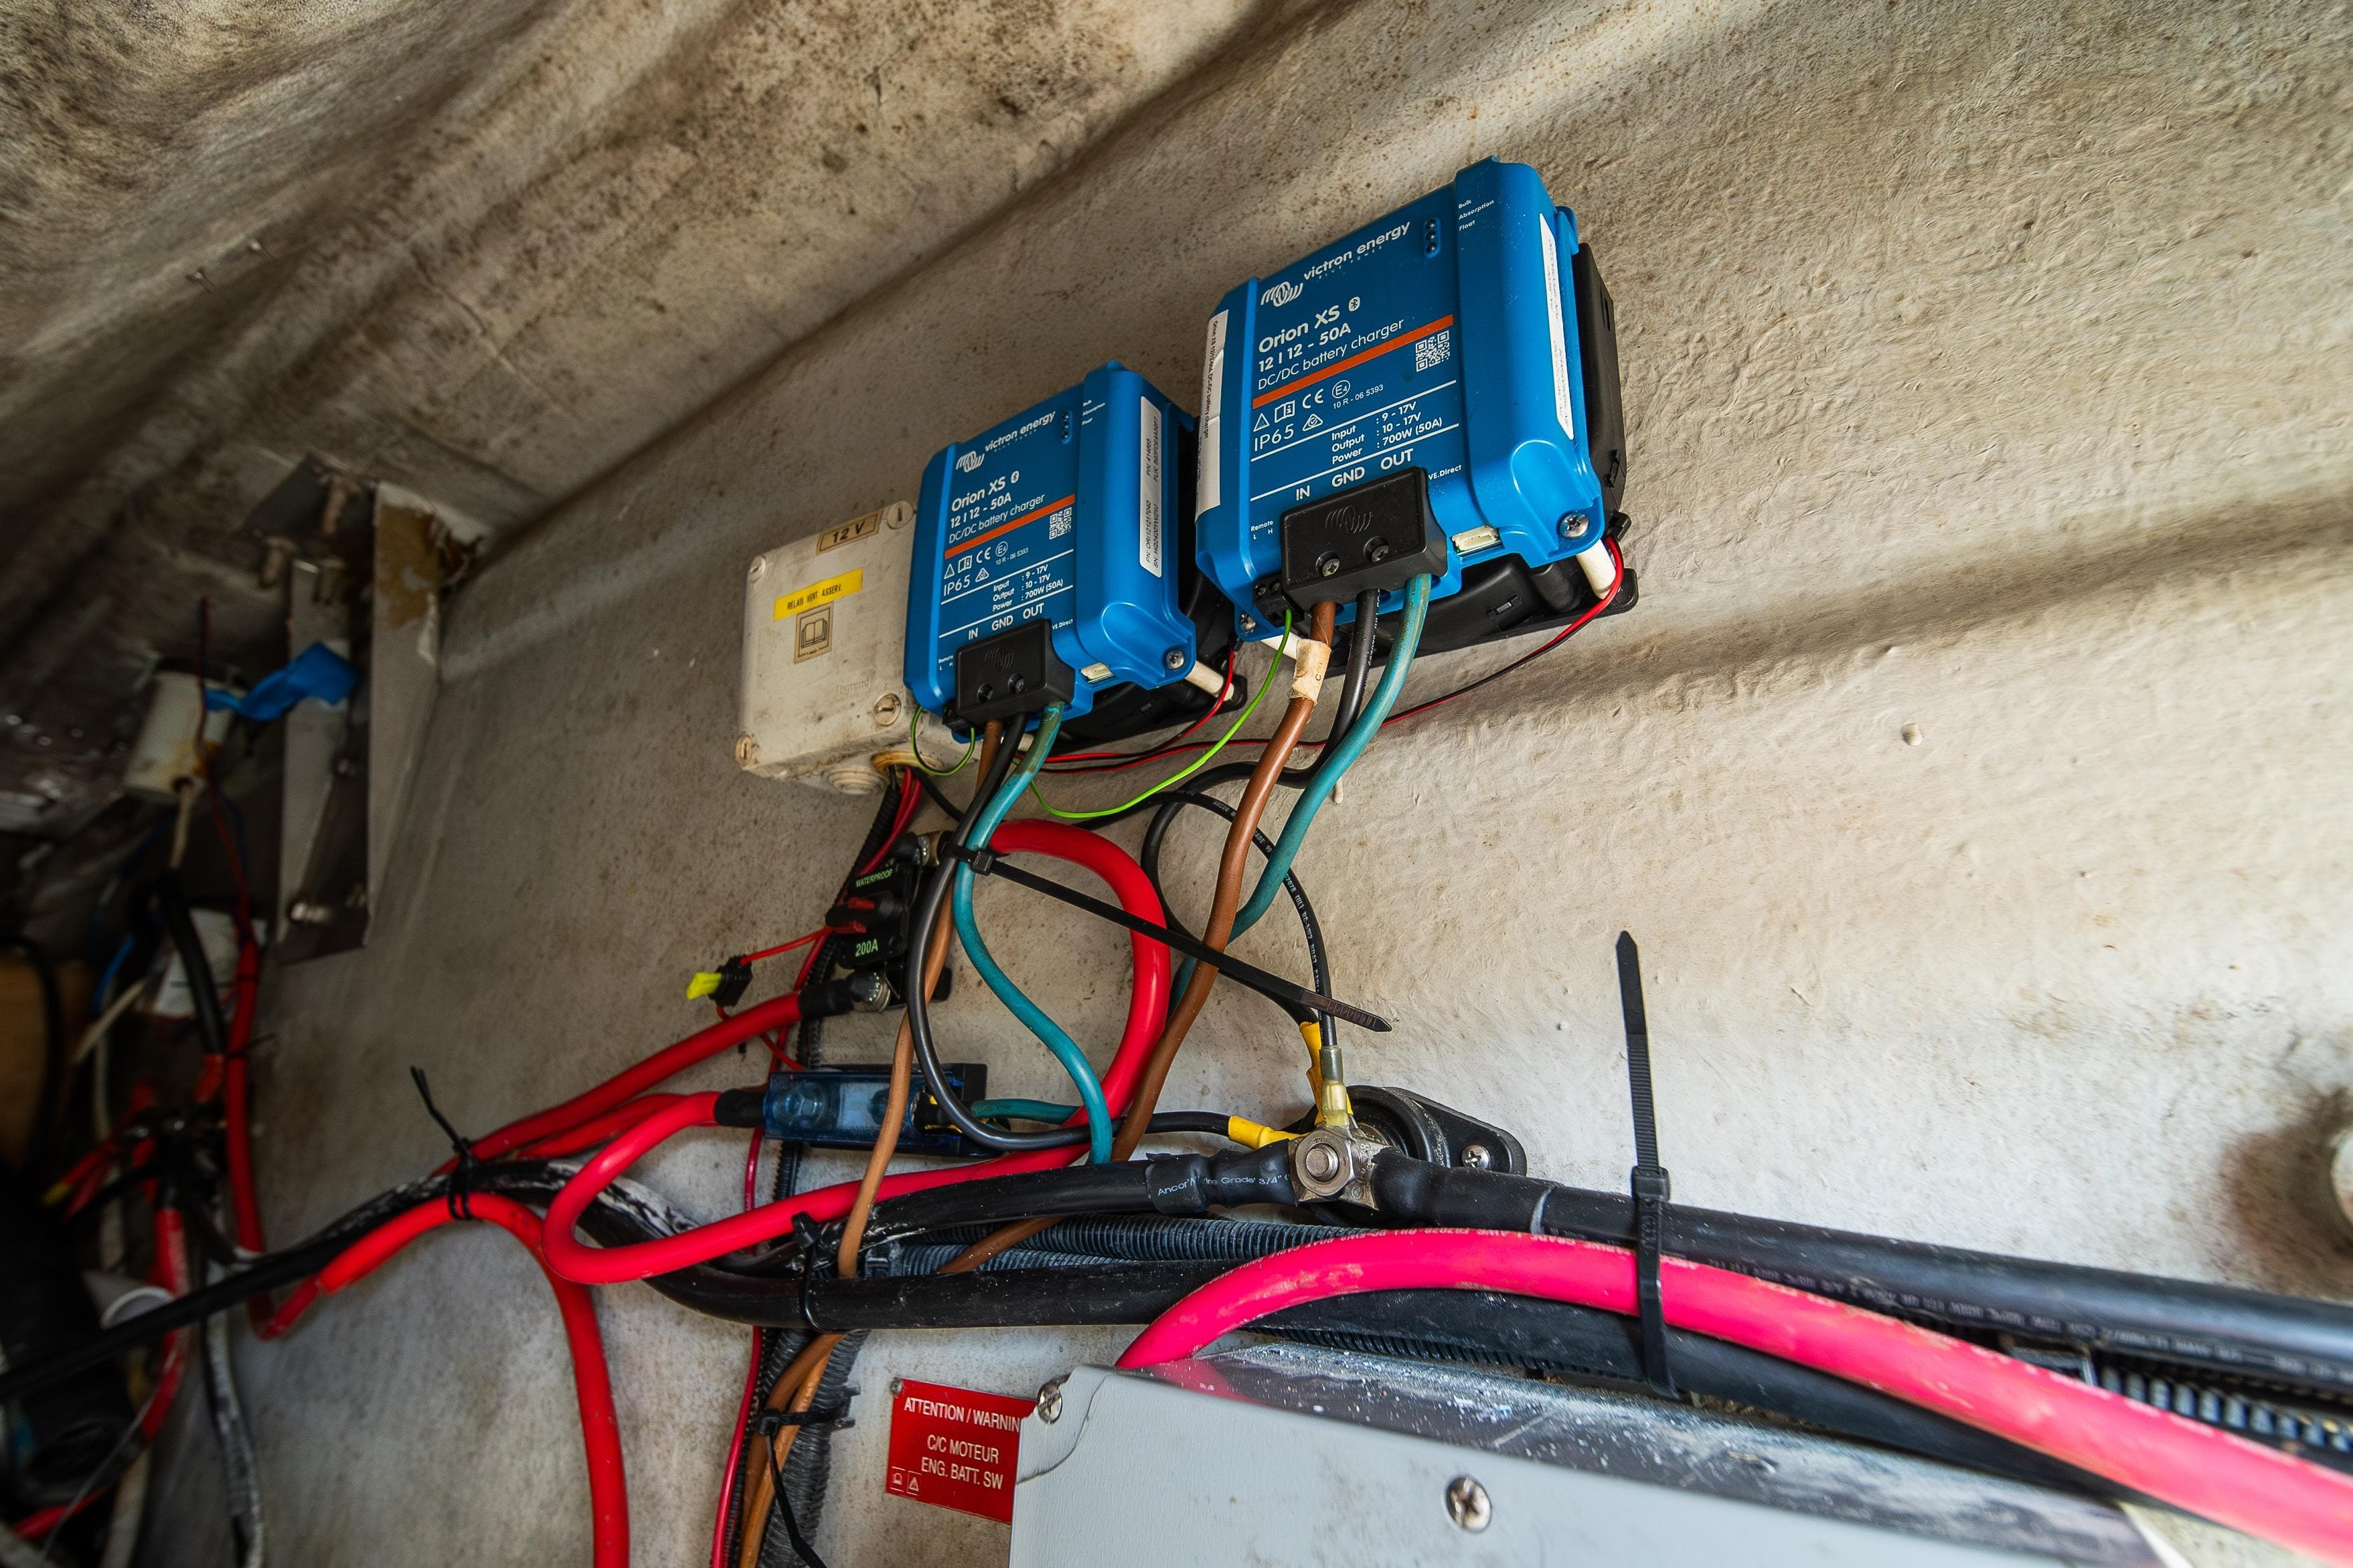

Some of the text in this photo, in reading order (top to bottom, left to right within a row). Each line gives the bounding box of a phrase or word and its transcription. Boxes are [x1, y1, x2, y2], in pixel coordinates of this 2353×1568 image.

[1459, 200, 1494, 220] Absorption
[1459, 220, 1475, 232] Float
[1303, 222, 1410, 281] victron energy
[1259, 304, 1340, 353] Orion XS
[1258, 356, 1274, 373] 12
[1287, 344, 1303, 361] 12
[1319, 325, 1351, 346] 50A
[1258, 319, 1404, 390] DC/DC battery charger
[1333, 402, 1341, 410] 10
[1343, 398, 1349, 406] R
[1354, 391, 1364, 402] 06
[1365, 384, 1384, 397] 5393
[985, 430, 1018, 452] victron
[1020, 411, 1056, 434] energy
[1253, 423, 1295, 452] IP65
[1331, 424, 1356, 441] Input
[1382, 412, 1388, 422] 9
[1398, 401, 1417, 415] 17V
[1331, 434, 1365, 452] Output
[1382, 423, 1394, 434] 10
[1402, 412, 1422, 426] 17V
[1331, 448, 1363, 465] Power
[1382, 430, 1412, 447] 700W
[1415, 417, 1443, 438] (50A)
[1296, 448, 1414, 501] IN GND OUT
[1428, 464, 1462, 481] VE.Direct
[951, 476, 1006, 512] Orion XS
[951, 515, 961, 529] 12
[969, 507, 980, 519] 12
[990, 492, 1011, 510] 50A
[832, 521, 866, 544] 12 V
[949, 495, 1046, 543] DC/DC battery charger
[1250, 520, 1273, 532] Remote
[943, 574, 971, 596] IP65
[993, 580, 1009, 592] Input
[1025, 572, 1031, 580] 9
[1036, 564, 1048, 575] 17V
[993, 588, 1015, 602] Output
[1025, 580, 1033, 589] 10
[1038, 573, 1051, 584] 17V
[993, 600, 1013, 612] Power
[1025, 586, 1045, 600] 700W
[1046, 578, 1064, 593] (50A)
[968, 602, 1044, 640] IN GND OUT
[856, 868, 893, 888] WATERPROOF
[855, 938, 878, 958] 200A
[904, 1397, 965, 1423] ATTENTION
[973, 1409, 1020, 1433] WARNIN
[926, 1434, 999, 1464] C/C MOTEUR
[920, 1457, 1004, 1490] ENG. BATT. SW
